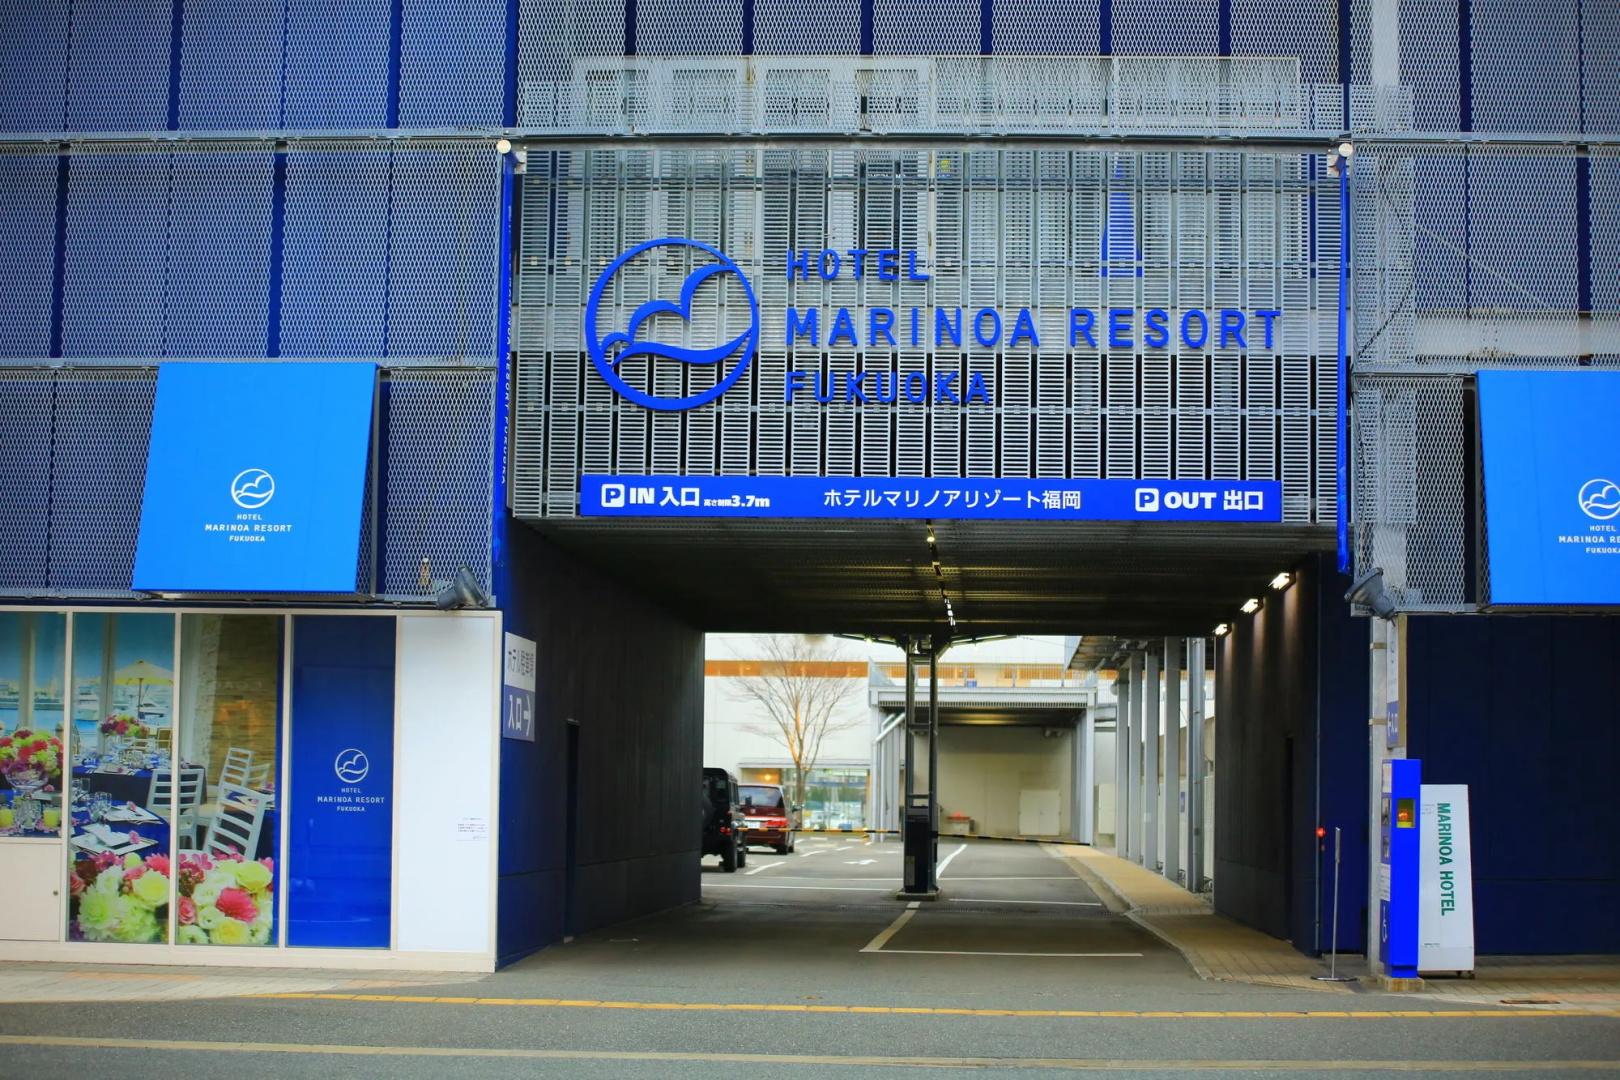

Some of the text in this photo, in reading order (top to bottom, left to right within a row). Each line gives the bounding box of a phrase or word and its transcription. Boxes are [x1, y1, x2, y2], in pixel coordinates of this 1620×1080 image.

[786, 248, 931, 281] HOTEL
[785, 307, 1281, 350] MARINOA RESORT
[785, 371, 990, 404] FUKUOKA
[629, 487, 655, 504] IN
[659, 486, 700, 507] 入口
[823, 489, 1082, 510] ホテルマリノアリゾート福岡
[1163, 491, 1217, 510] OUT
[1223, 489, 1264, 511] 出口
[204, 524, 293, 532] MARINOA RESORT
[1558, 535, 1605, 543] MARINOA
[508, 694, 521, 730] 入口
[1437, 802, 1455, 916] MARINOA HOTEL
